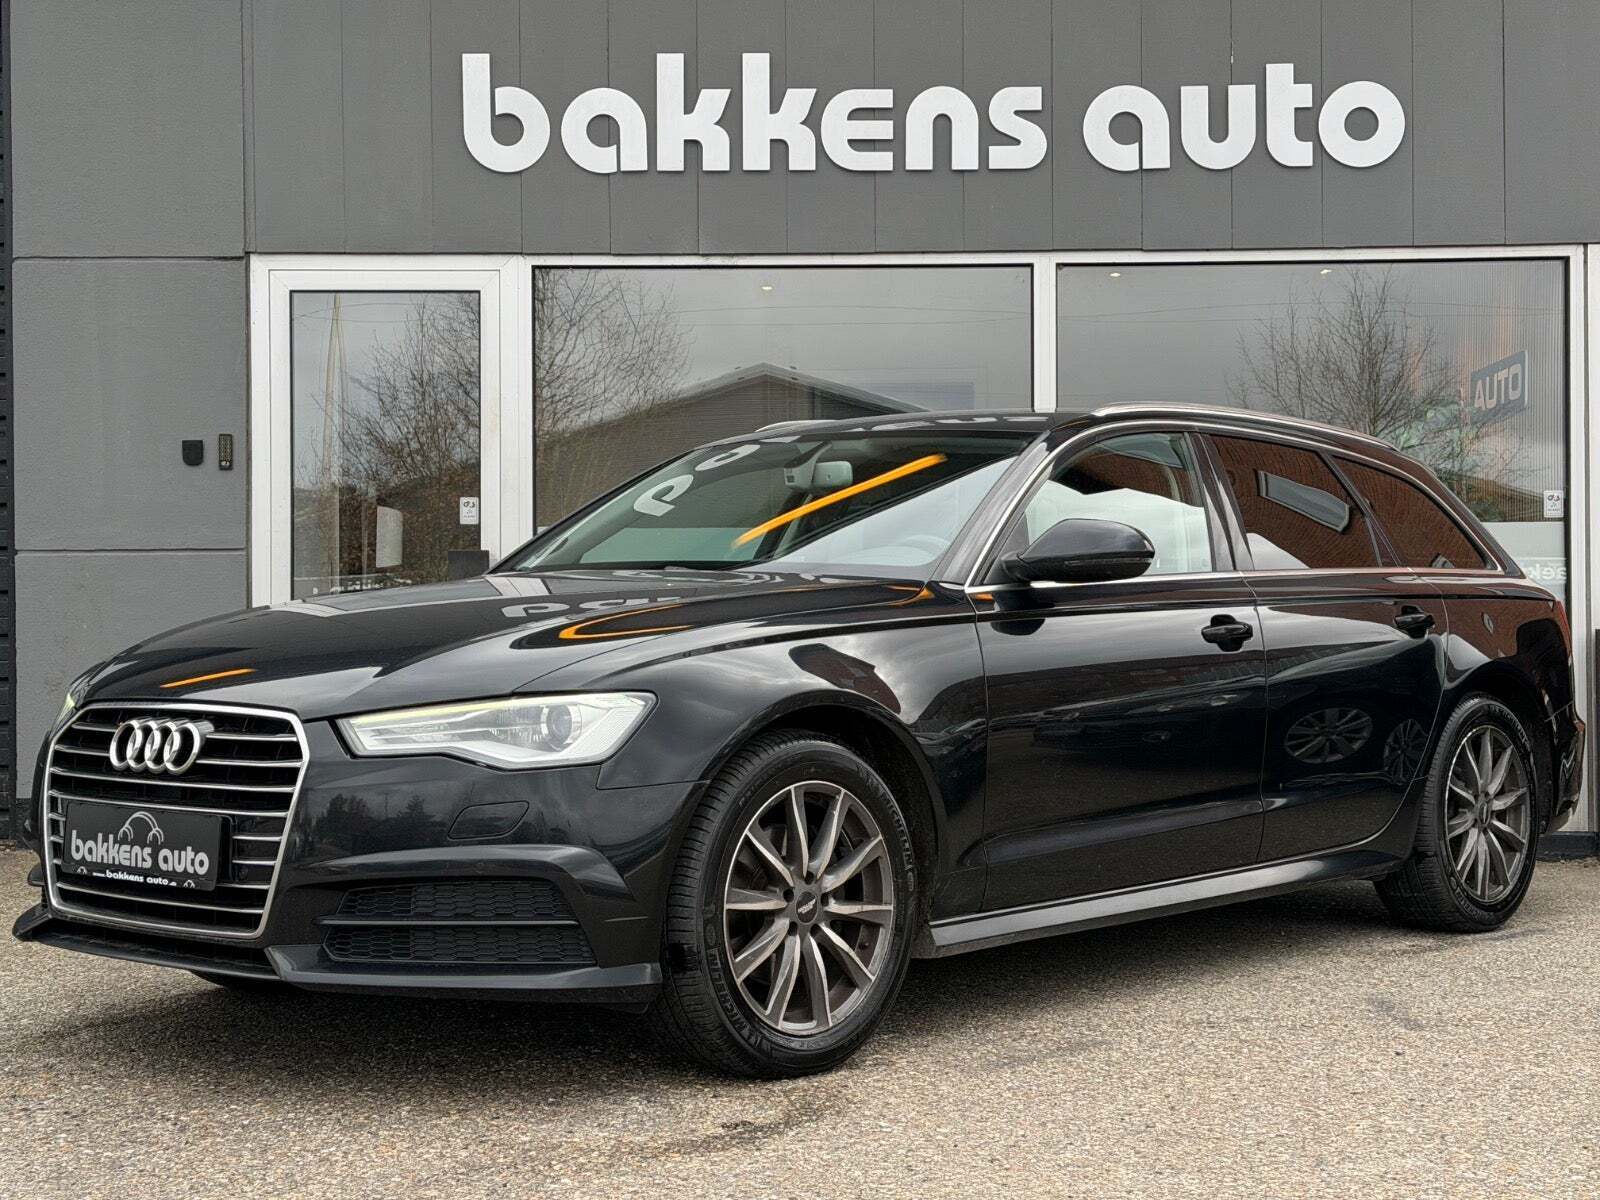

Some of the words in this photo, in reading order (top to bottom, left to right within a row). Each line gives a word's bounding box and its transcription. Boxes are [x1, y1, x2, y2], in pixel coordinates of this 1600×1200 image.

[461, 52, 1048, 174] bakkens
[1082, 62, 1406, 172] auto
[1474, 363, 1522, 411] AUTO
[71, 829, 152, 869] bakkens
[157, 845, 210, 876] auto
[105, 869, 145, 883] bakkens
[146, 876, 169, 886] auto
